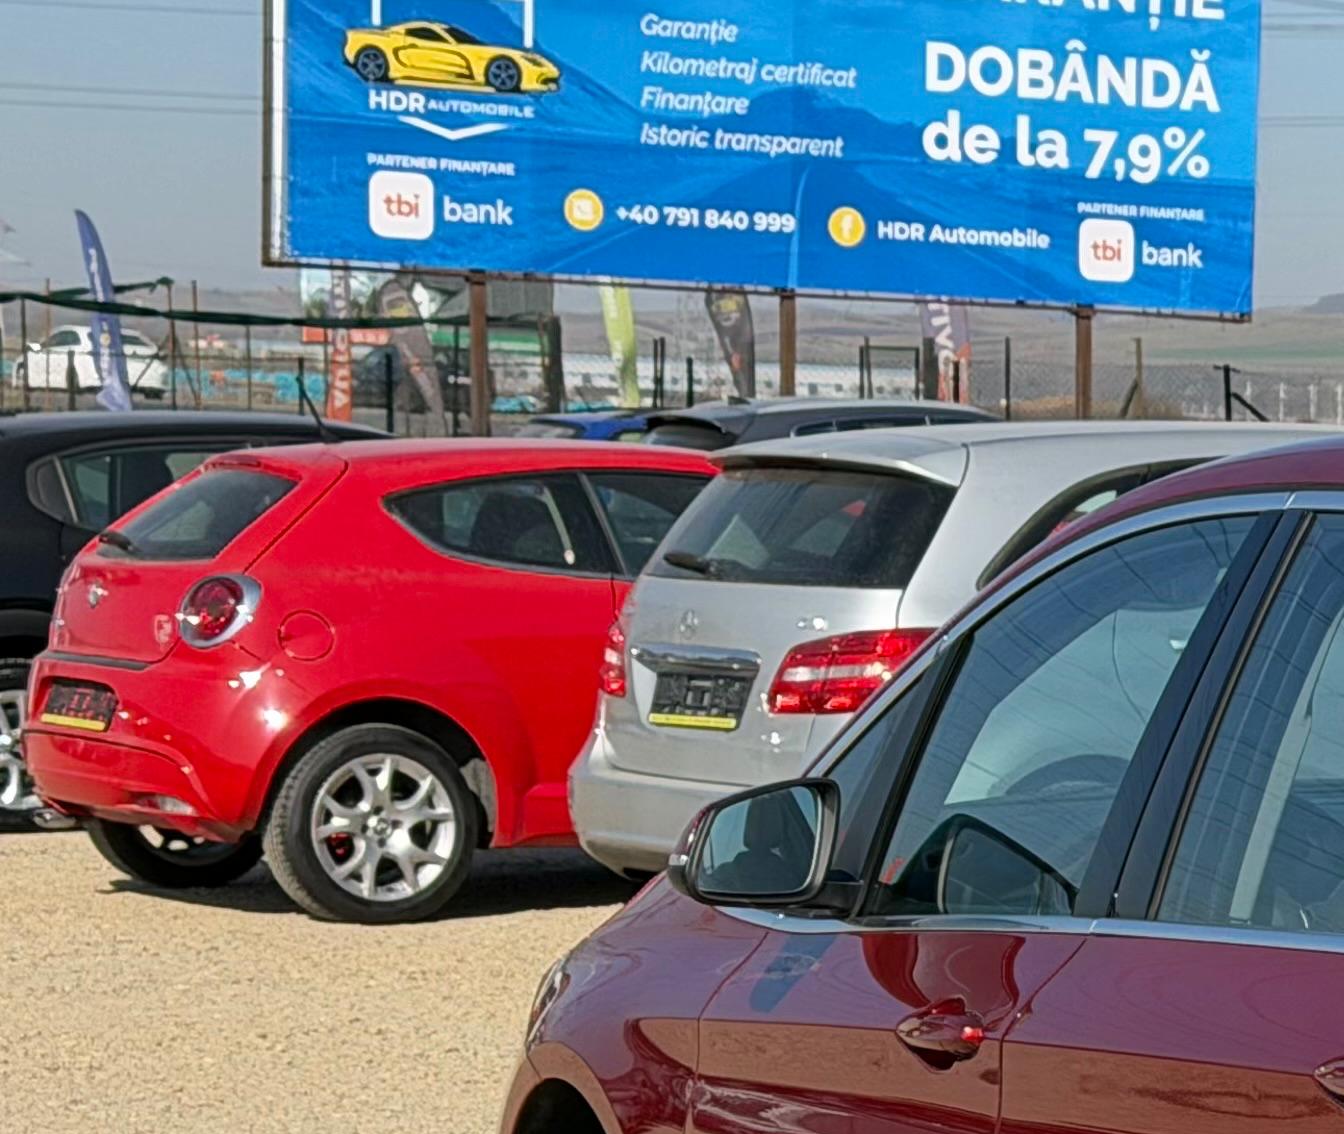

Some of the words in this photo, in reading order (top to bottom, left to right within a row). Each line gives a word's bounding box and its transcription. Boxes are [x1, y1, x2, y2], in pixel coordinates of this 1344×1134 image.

[640, 13, 739, 46] Garanție
[640, 50, 759, 84] Kilometraj
[760, 62, 857, 88] certificat
[925, 38, 1221, 113] DOBÂNDĂ
[369, 89, 425, 113] HDR
[428, 99, 535, 118] AUTOMOBILE
[640, 86, 750, 118] Finanțare
[640, 123, 711, 148] Istoric
[715, 128, 845, 158] transparent
[922, 109, 1001, 164] de
[1016, 113, 1070, 170] la
[1083, 126, 1210, 184] 7,9%
[367, 153, 437, 170] PARTENER
[383, 193, 420, 218] tbi
[443, 195, 513, 225] bank
[616, 204, 659, 225] +40
[663, 206, 699, 227] 791
[704, 208, 749, 231] 840
[753, 211, 796, 233] 999
[1077, 202, 1137, 217] PARTENER
[877, 220, 926, 242] HDR
[929, 223, 1050, 249] Automobile
[1090, 238, 1122, 262] tbi
[1142, 240, 1203, 269] bank
